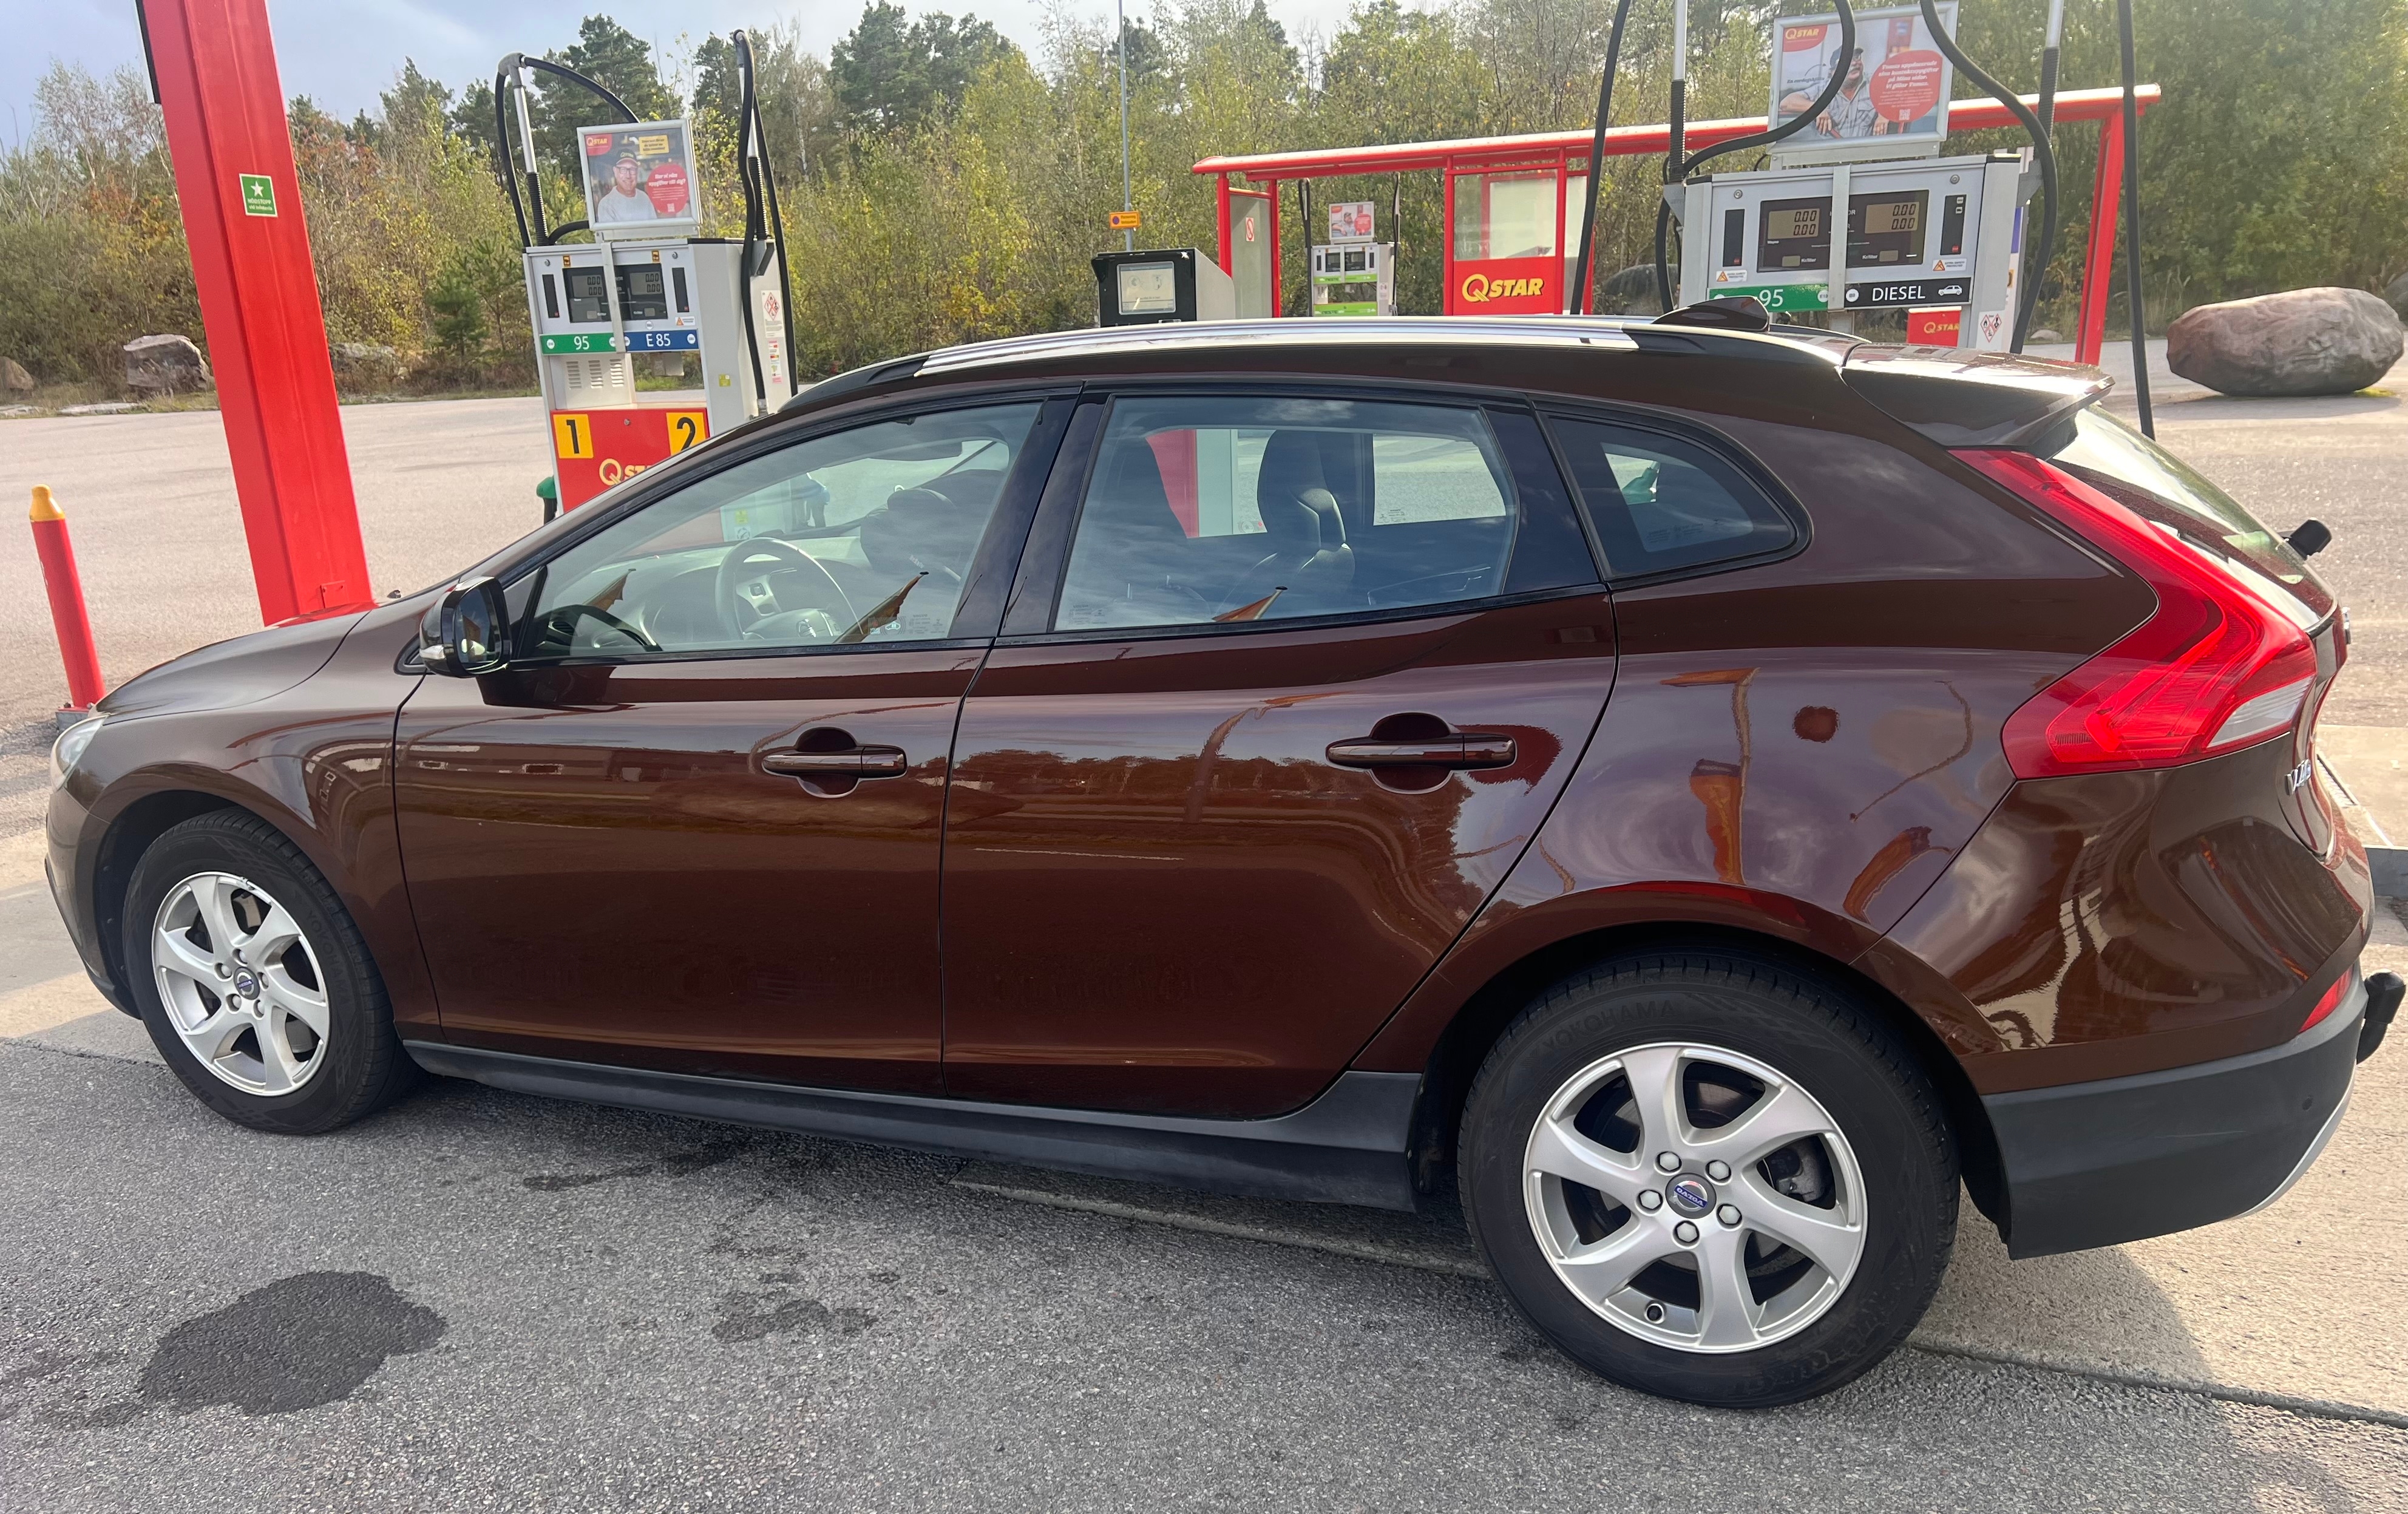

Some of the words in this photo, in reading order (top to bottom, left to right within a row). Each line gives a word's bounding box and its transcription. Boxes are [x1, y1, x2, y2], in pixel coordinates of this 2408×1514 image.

[1785, 28, 1819, 39] QSTAR
[586, 137, 608, 146] QSTAR
[1892, 204, 1916, 216] 0.00
[1794, 211, 1817, 223] 0.00
[1891, 217, 1915, 229] 0.00
[1793, 224, 1816, 236] 0.00
[588, 276, 601, 285] 0.00
[645, 273, 659, 282] 0.00
[589, 287, 602, 296] 0.00
[646, 283, 660, 293] 0.00
[1462, 273, 1544, 302] QSTAR
[1872, 285, 1926, 302] DIESEL
[1760, 288, 1784, 307] 95
[574, 336, 590, 350] 95
[656, 333, 671, 347] 85
[566, 419, 580, 454] 1
[677, 417, 696, 451] 2
[599, 458, 652, 486] QST
[1542, 1000, 1675, 1050] YOKOHAMA
[1677, 1187, 1704, 1206] VOLVO
